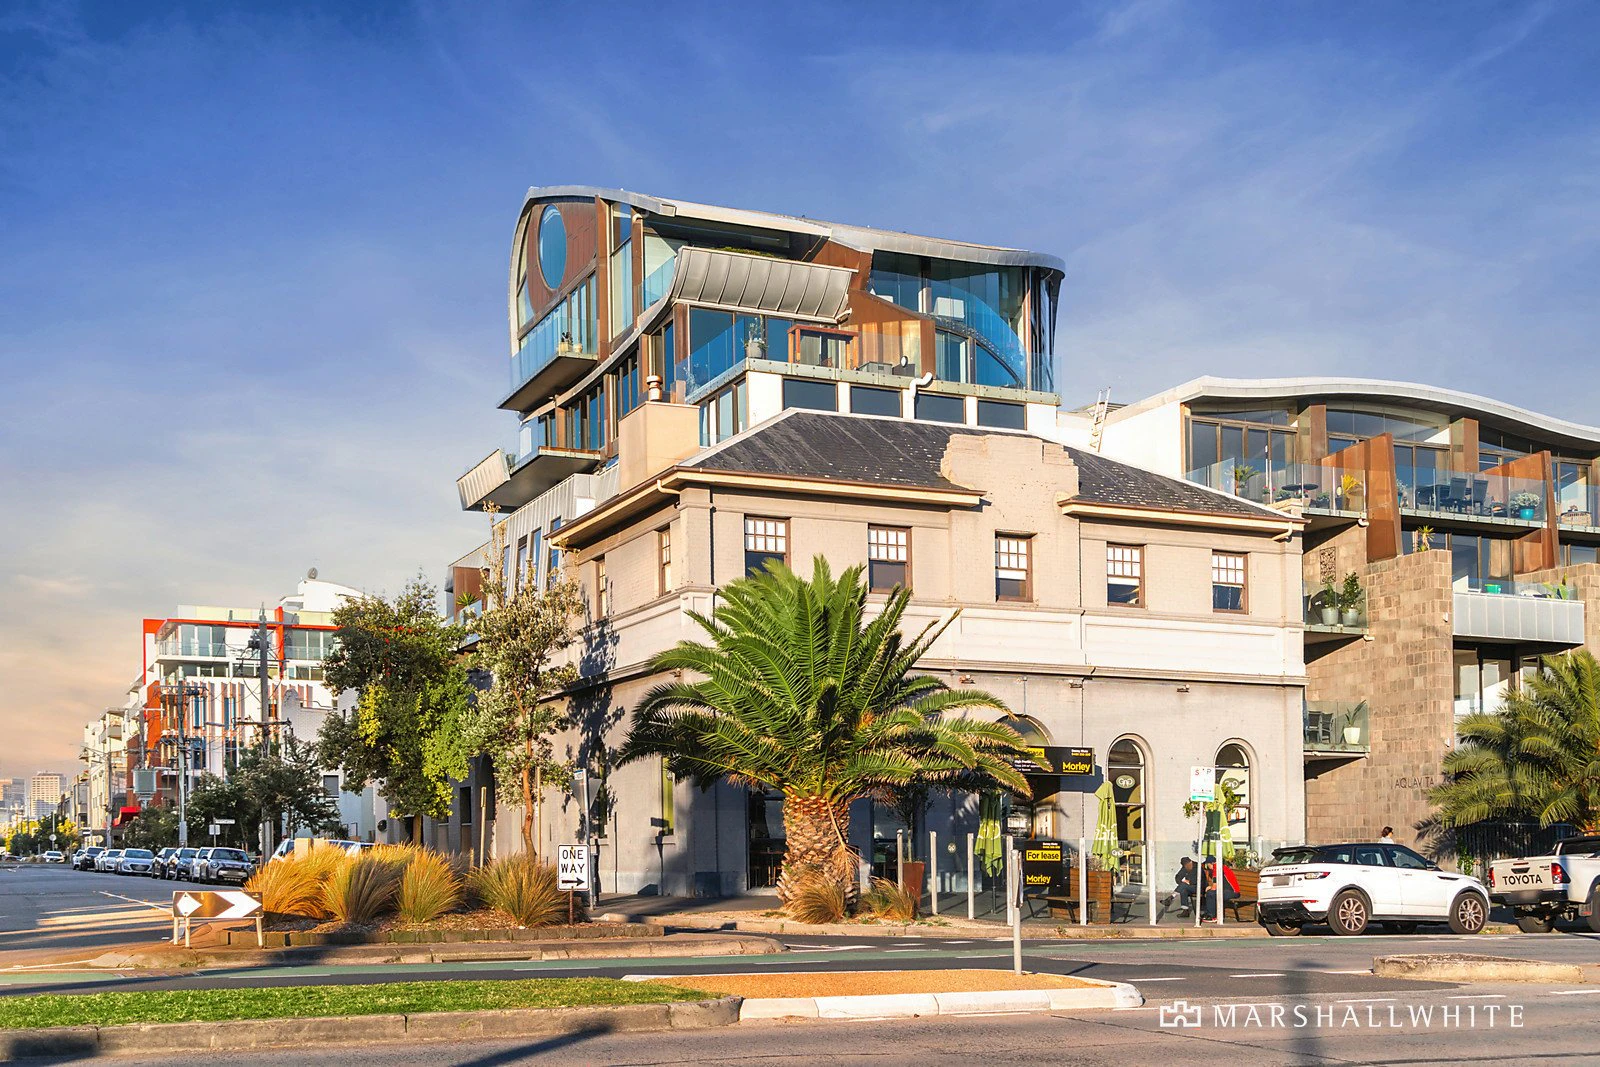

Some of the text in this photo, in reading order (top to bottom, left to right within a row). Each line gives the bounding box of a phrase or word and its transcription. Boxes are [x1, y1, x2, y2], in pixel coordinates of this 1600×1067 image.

[1062, 762, 1091, 772] Morley
[562, 849, 584, 859] ONE
[561, 864, 585, 874] WAY
[1026, 875, 1051, 884] Morley
[1502, 874, 1543, 885] TOYOTA
